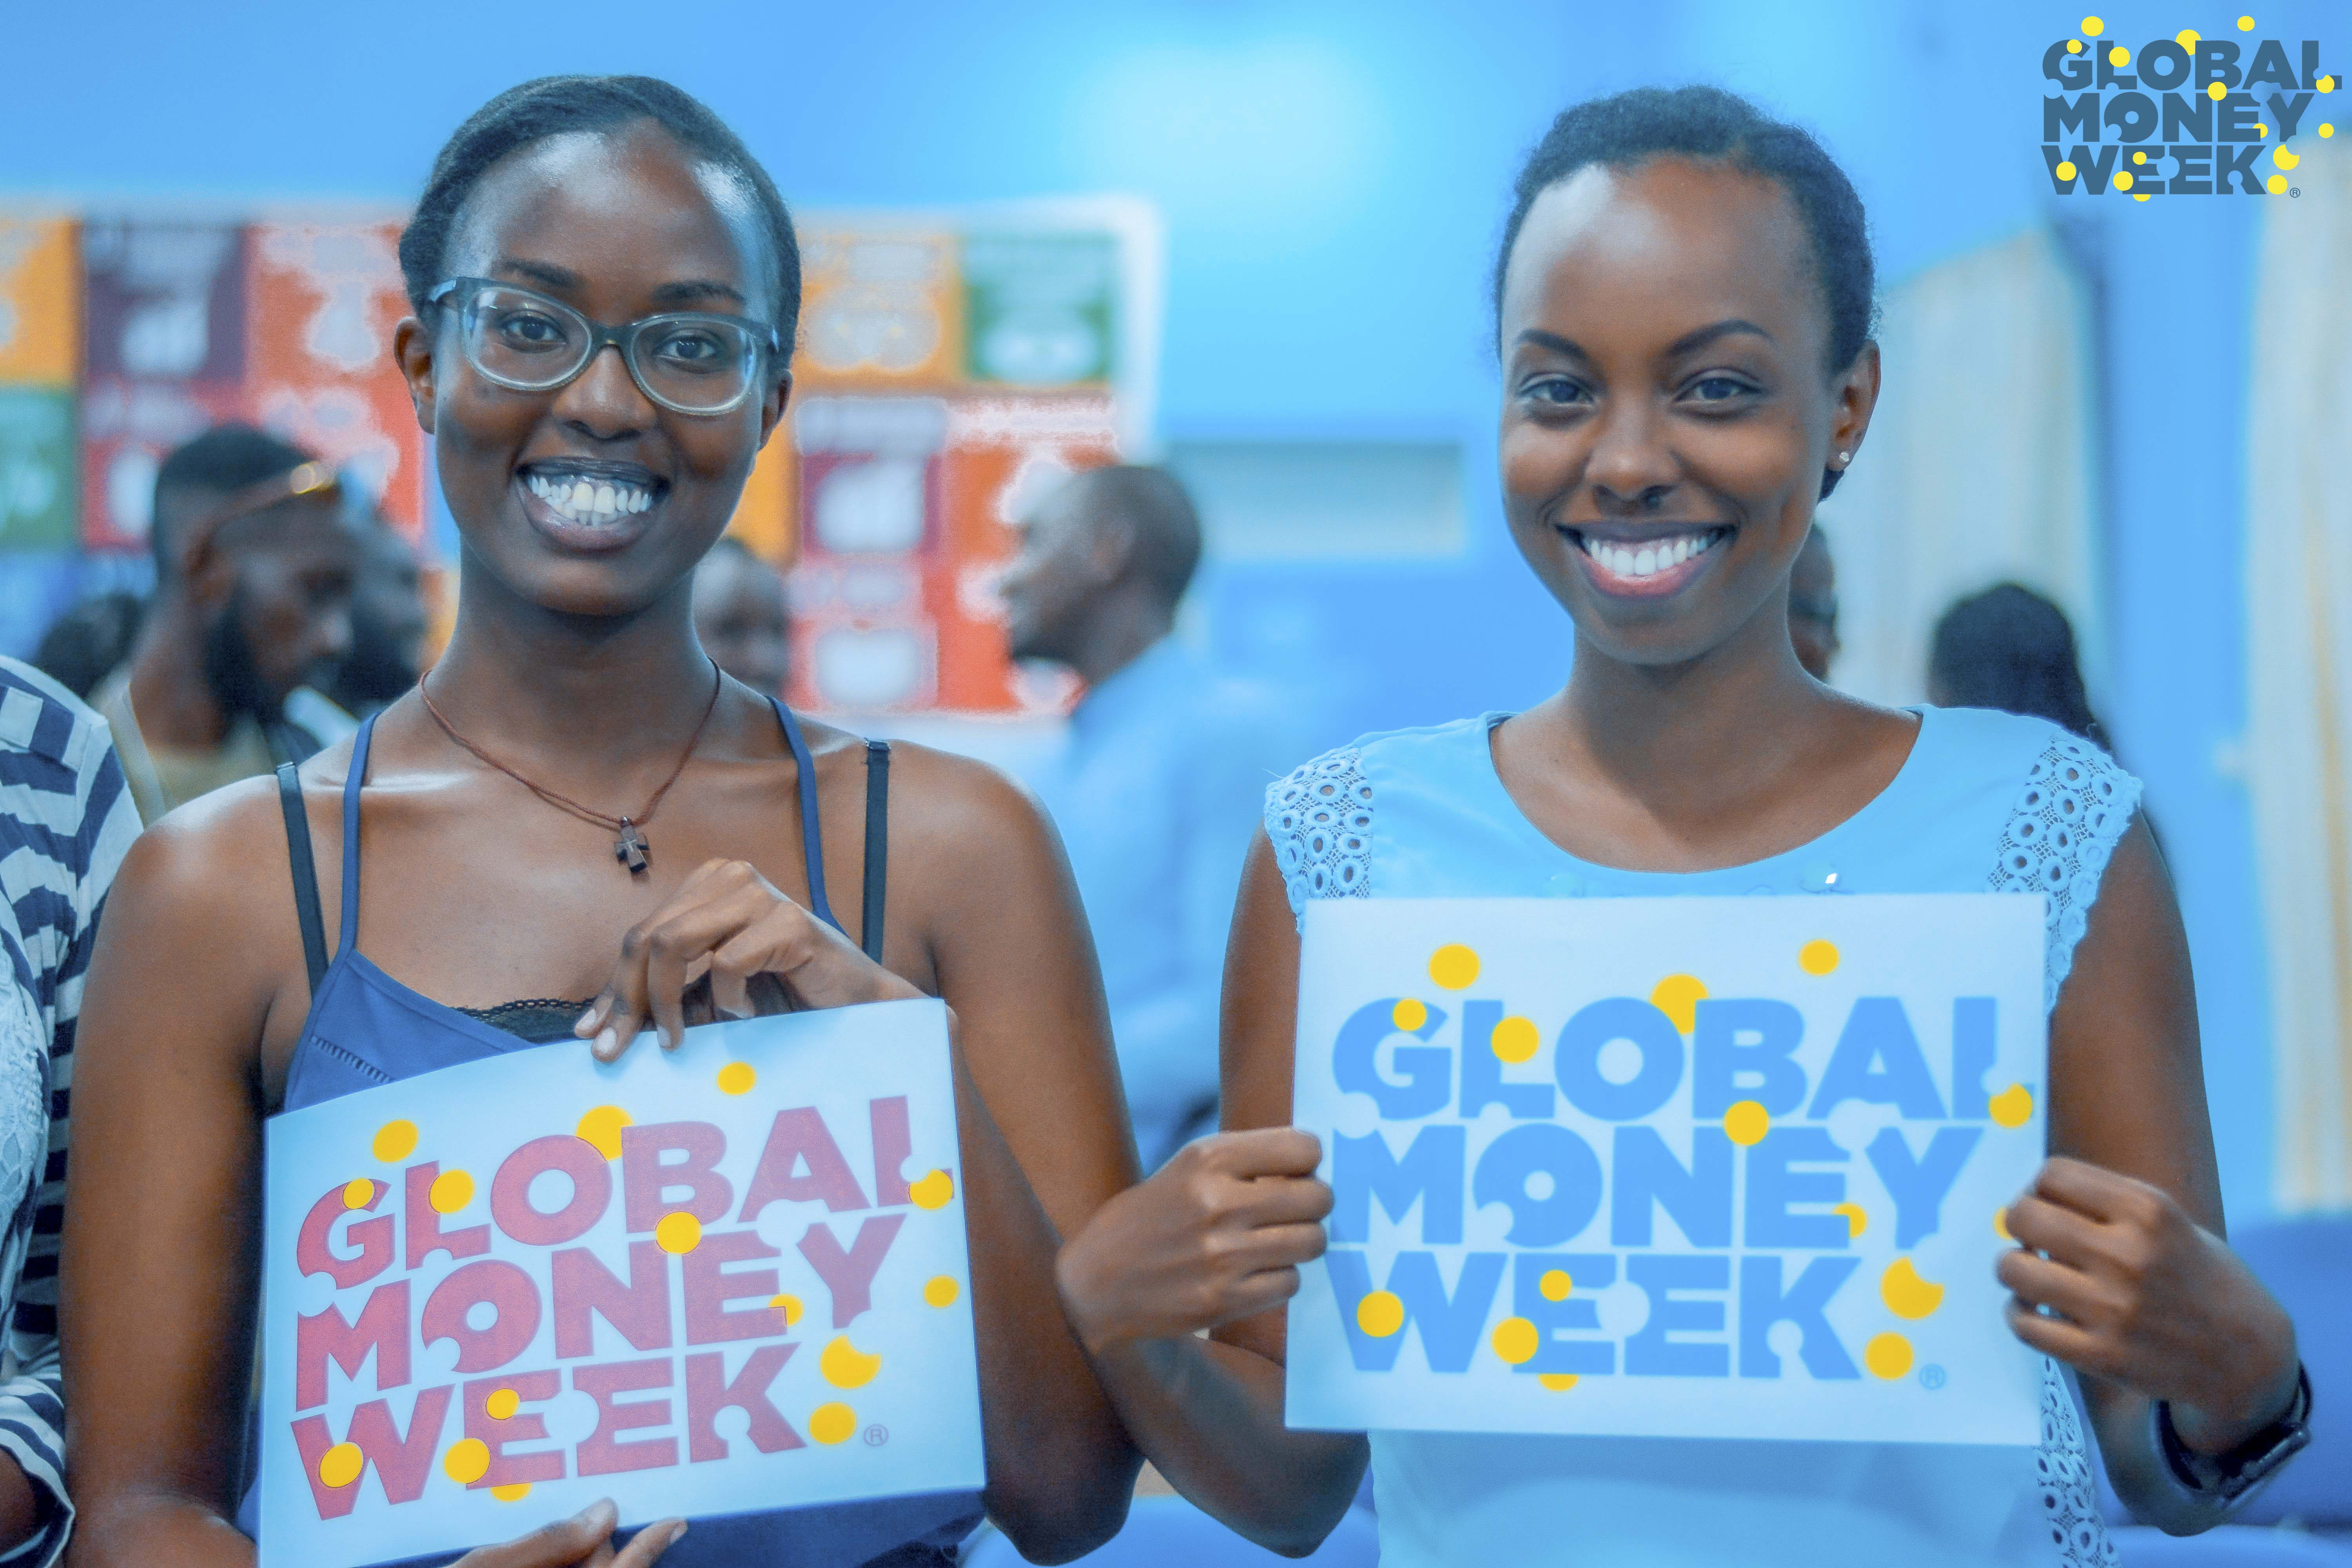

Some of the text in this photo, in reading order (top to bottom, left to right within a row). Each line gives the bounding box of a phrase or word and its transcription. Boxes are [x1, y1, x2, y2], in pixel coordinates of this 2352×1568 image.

[1332, 996, 2034, 1121] GLOBAL
[297, 1095, 953, 1290] GLOBAL
[1330, 1123, 1983, 1249] MONEY
[296, 1214, 907, 1412] MONEY
[1325, 1250, 1861, 1379] WEEK
[290, 1343, 808, 1521] WEEK
